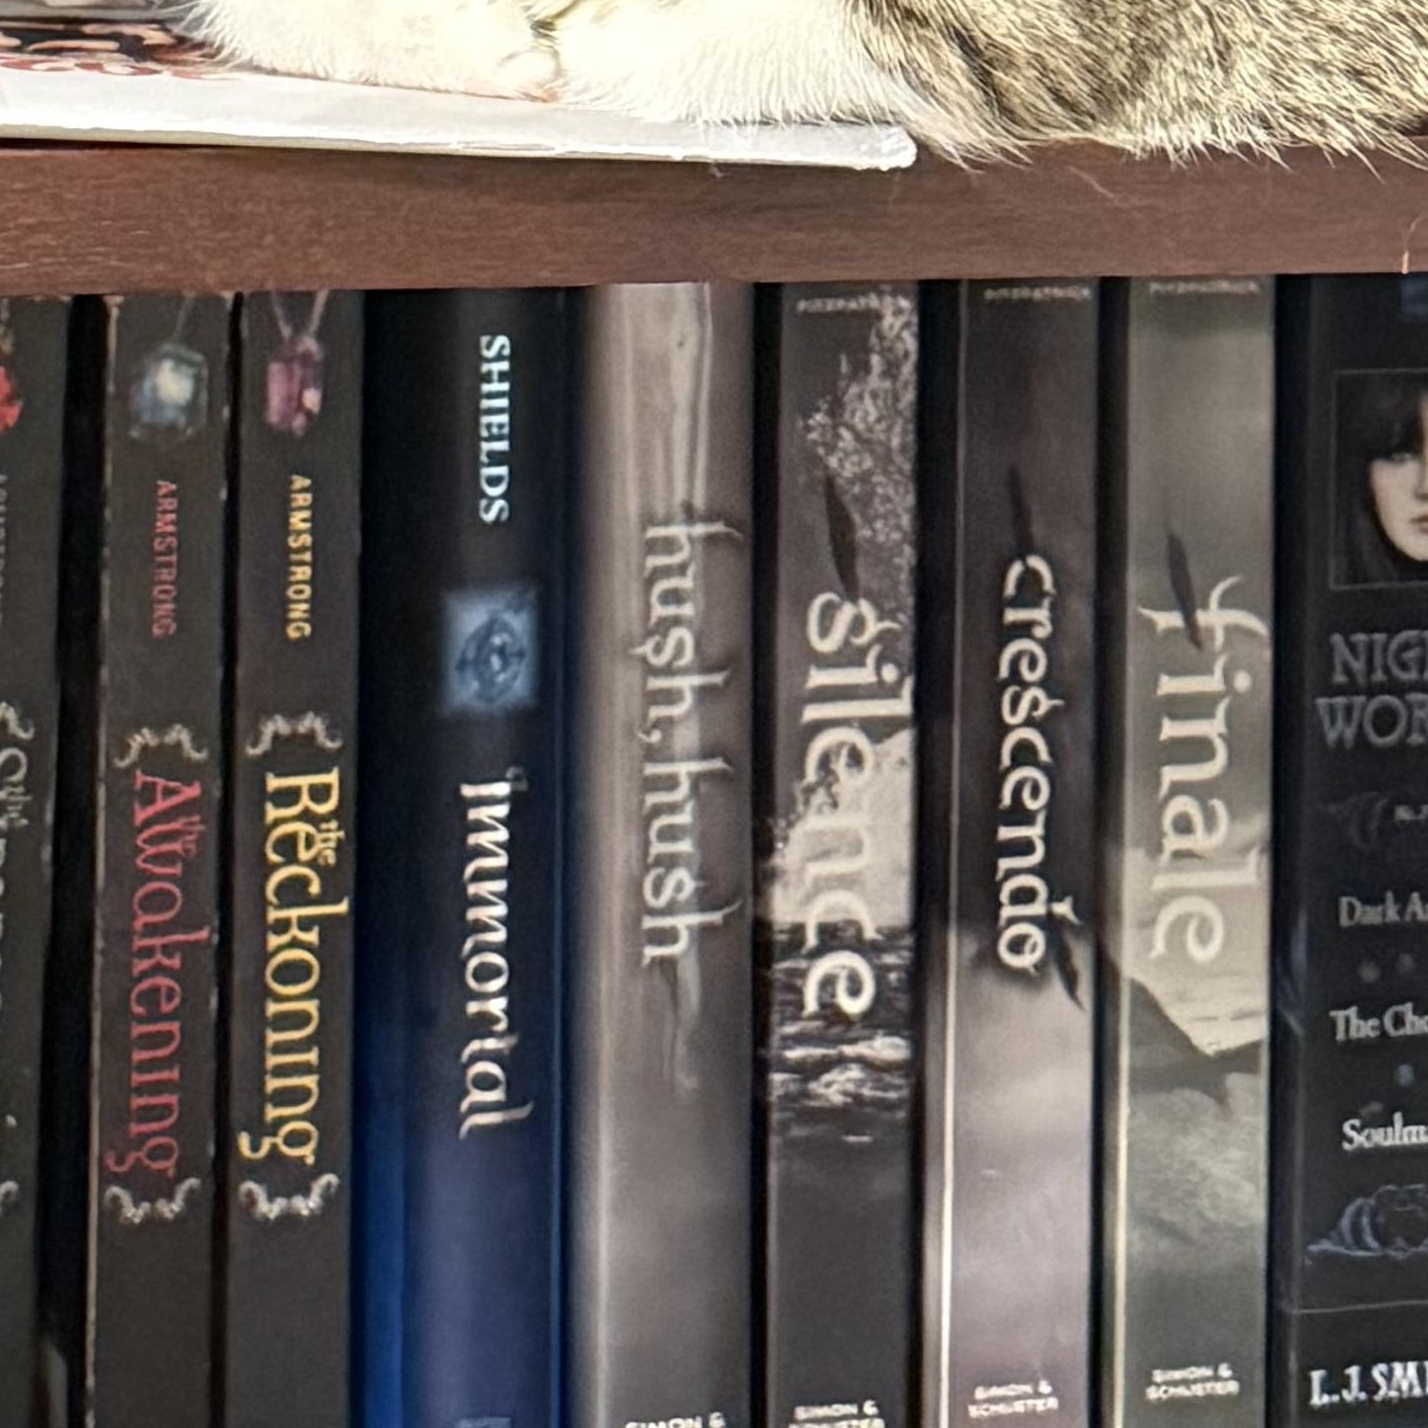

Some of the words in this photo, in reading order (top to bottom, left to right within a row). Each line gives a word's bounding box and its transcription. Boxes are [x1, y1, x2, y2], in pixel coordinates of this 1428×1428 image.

[479, 334, 511, 526] SHIELDS
[151, 481, 178, 638] ARMSTRONG
[285, 475, 313, 639] ARMSTRONG
[631, 521, 743, 744] hush,
[315, 820, 346, 866] the
[641, 755, 743, 967] hush
[801, 591, 914, 1018] silence
[996, 554, 1081, 975] crescendo
[1138, 576, 1268, 963] finale
[106, 770, 210, 1176] Awakening
[237, 766, 349, 1166] Reckoning
[459, 780, 534, 1139] Immortal
[1339, 894, 1399, 927] Dark
[1329, 1009, 1380, 1042] The
